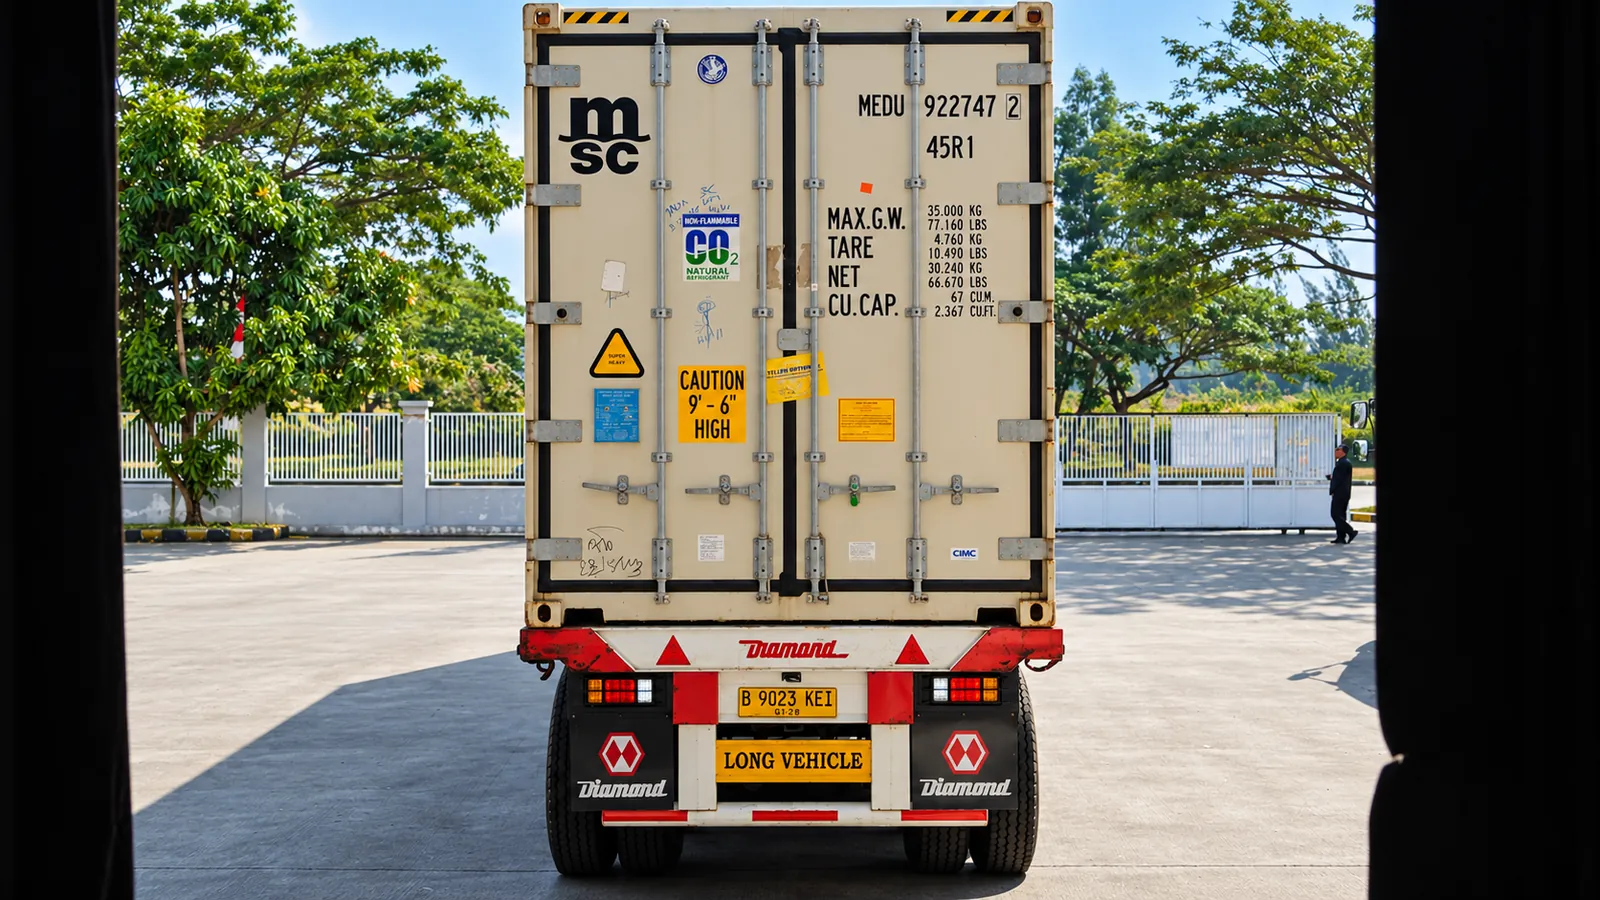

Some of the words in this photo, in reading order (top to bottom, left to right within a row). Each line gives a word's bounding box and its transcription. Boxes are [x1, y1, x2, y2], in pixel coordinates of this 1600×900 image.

[859, 95, 904, 116] MEDU
[925, 95, 996, 117] 922747
[1009, 96, 1018, 117] 2
[927, 136, 972, 158] 45R1
[828, 207, 905, 229] MAX.G.W.
[928, 205, 963, 216] 35.000
[970, 205, 981, 216] KG
[684, 215, 738, 225] NON-FLAMMABLE
[928, 219, 963, 230] 77.160
[970, 219, 987, 230] LBS
[828, 236, 873, 258] TARE
[935, 234, 963, 245] 4.760
[970, 234, 981, 245] KG
[930, 247, 963, 259] 10.490
[970, 248, 987, 259] LBS
[686, 267, 730, 275] NATURAL
[829, 265, 860, 287] NET
[929, 262, 963, 273] 30.240
[970, 262, 982, 273] KG
[929, 277, 963, 288] 66.670
[970, 276, 987, 287] LBS
[829, 294, 898, 316] CU.CAP.
[951, 291, 963, 302] 67
[935, 306, 963, 317] 2.367
[681, 370, 744, 390] CAUTION
[695, 419, 730, 438] HIGH
[952, 549, 977, 557] CIMC
[739, 640, 848, 658] Diamond
[742, 689, 751, 707] B
[758, 689, 797, 707] 9023
[805, 689, 833, 707] KEI
[724, 752, 774, 769] LONG
[781, 752, 862, 769] VEHICLE
[577, 779, 667, 797] Diamond
[920, 778, 1011, 796] Diamond
